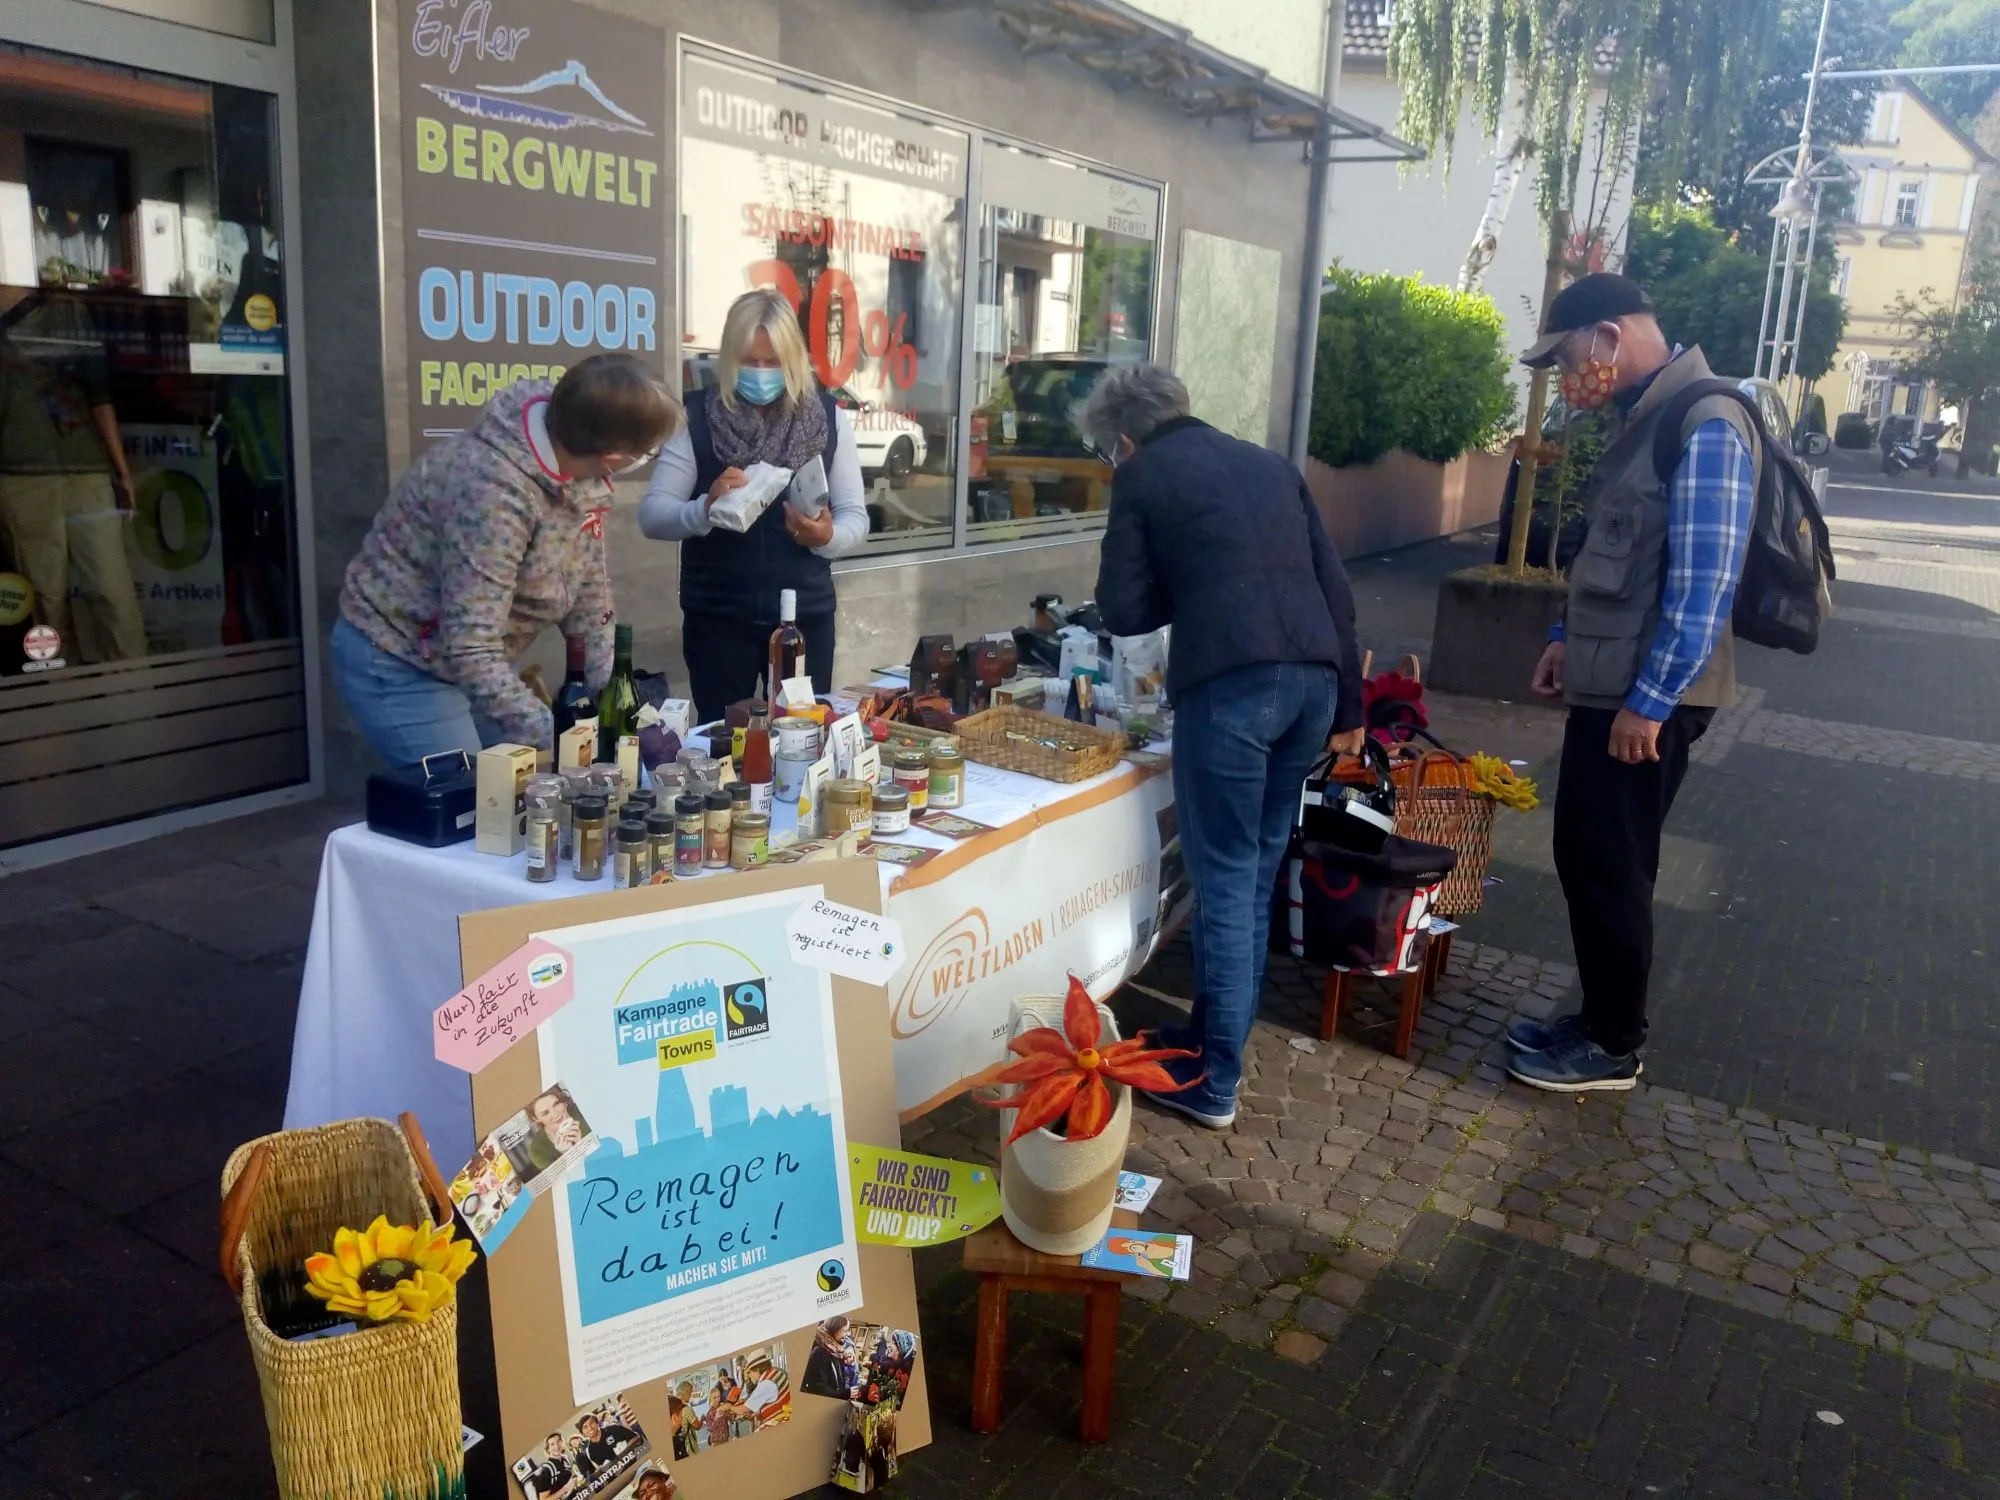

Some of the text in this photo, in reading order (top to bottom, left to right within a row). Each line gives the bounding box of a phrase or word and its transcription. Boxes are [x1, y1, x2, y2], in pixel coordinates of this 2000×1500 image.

[412, 0, 530, 74] Eifler
[697, 87, 809, 148] OUTDOOR
[416, 117, 657, 208] BERGWELT
[745, 202, 922, 262] SAISONFINALE
[418, 267, 656, 351] OUTDOOR
[150, 582, 223, 602] Artikel
[811, 900, 880, 932] Remagen
[831, 923, 852, 937] ist
[932, 859, 1154, 997] WELTLADEN REMAGEN-SINZIG
[792, 932, 872, 960] registriert
[438, 994, 475, 1031] (Nur)
[478, 972, 519, 1009] fair
[474, 989, 539, 1047] Zukunft
[617, 996, 707, 1025] Kampagne
[454, 1002, 500, 1041] in die
[618, 1009, 718, 1046] Fairtrade
[728, 1022, 768, 1038] FAIRTRADE
[660, 1039, 713, 1060] Towns
[578, 1151, 800, 1227] Remagen
[876, 1158, 951, 1193] WIR SIND
[661, 1200, 701, 1230] ist
[859, 1182, 958, 1219] FAIRRÜCKT!
[866, 1209, 942, 1241] UND DU?
[666, 1246, 768, 1291] MACHEN SIE MIT!
[816, 1288, 849, 1305] FAIRTRADE
[588, 1450, 636, 1492] FAIRTRADE
